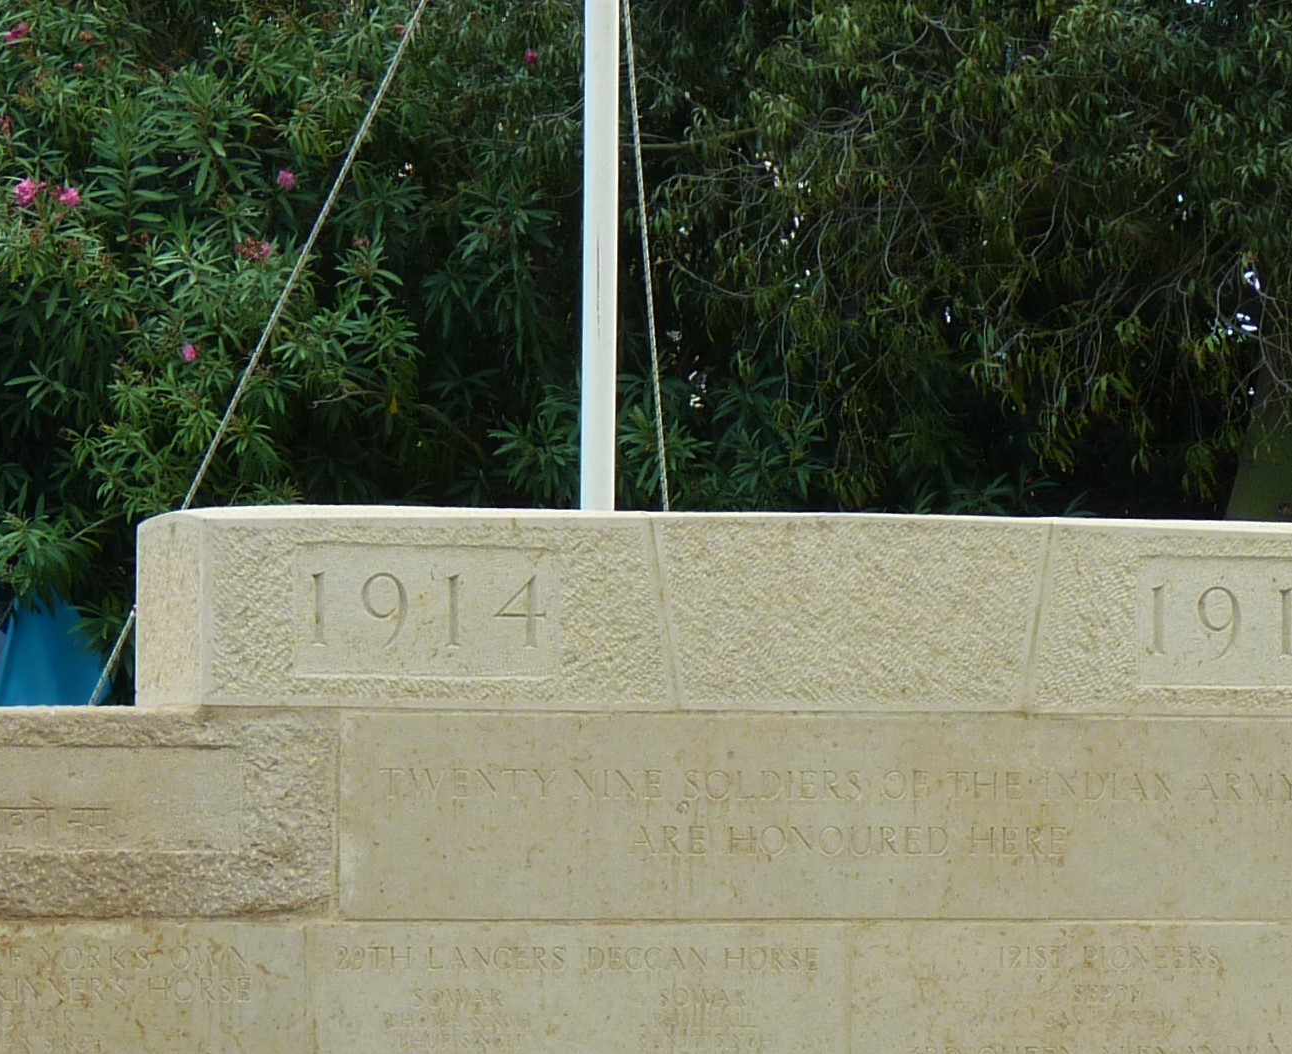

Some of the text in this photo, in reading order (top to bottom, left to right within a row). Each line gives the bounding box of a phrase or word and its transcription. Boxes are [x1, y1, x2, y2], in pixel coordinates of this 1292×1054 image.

[310, 570, 547, 649] 1914
[380, 767, 555, 800] TWENTY
[572, 768, 662, 800] NINE
[683, 768, 863, 801] SOLDIERS
[881, 768, 928, 801] OF
[946, 768, 1023, 801] THE
[1044, 769, 1176, 803] INDIAN
[631, 825, 1068, 858] ARE HONOURED HERE
[169, 945, 248, 970] OWN
[427, 945, 567, 971] LANCERS
[999, 944, 1223, 972] 121ST PIONEERS
[147, 977, 252, 1003] HORSE
[411, 987, 504, 1008] SOWAR
